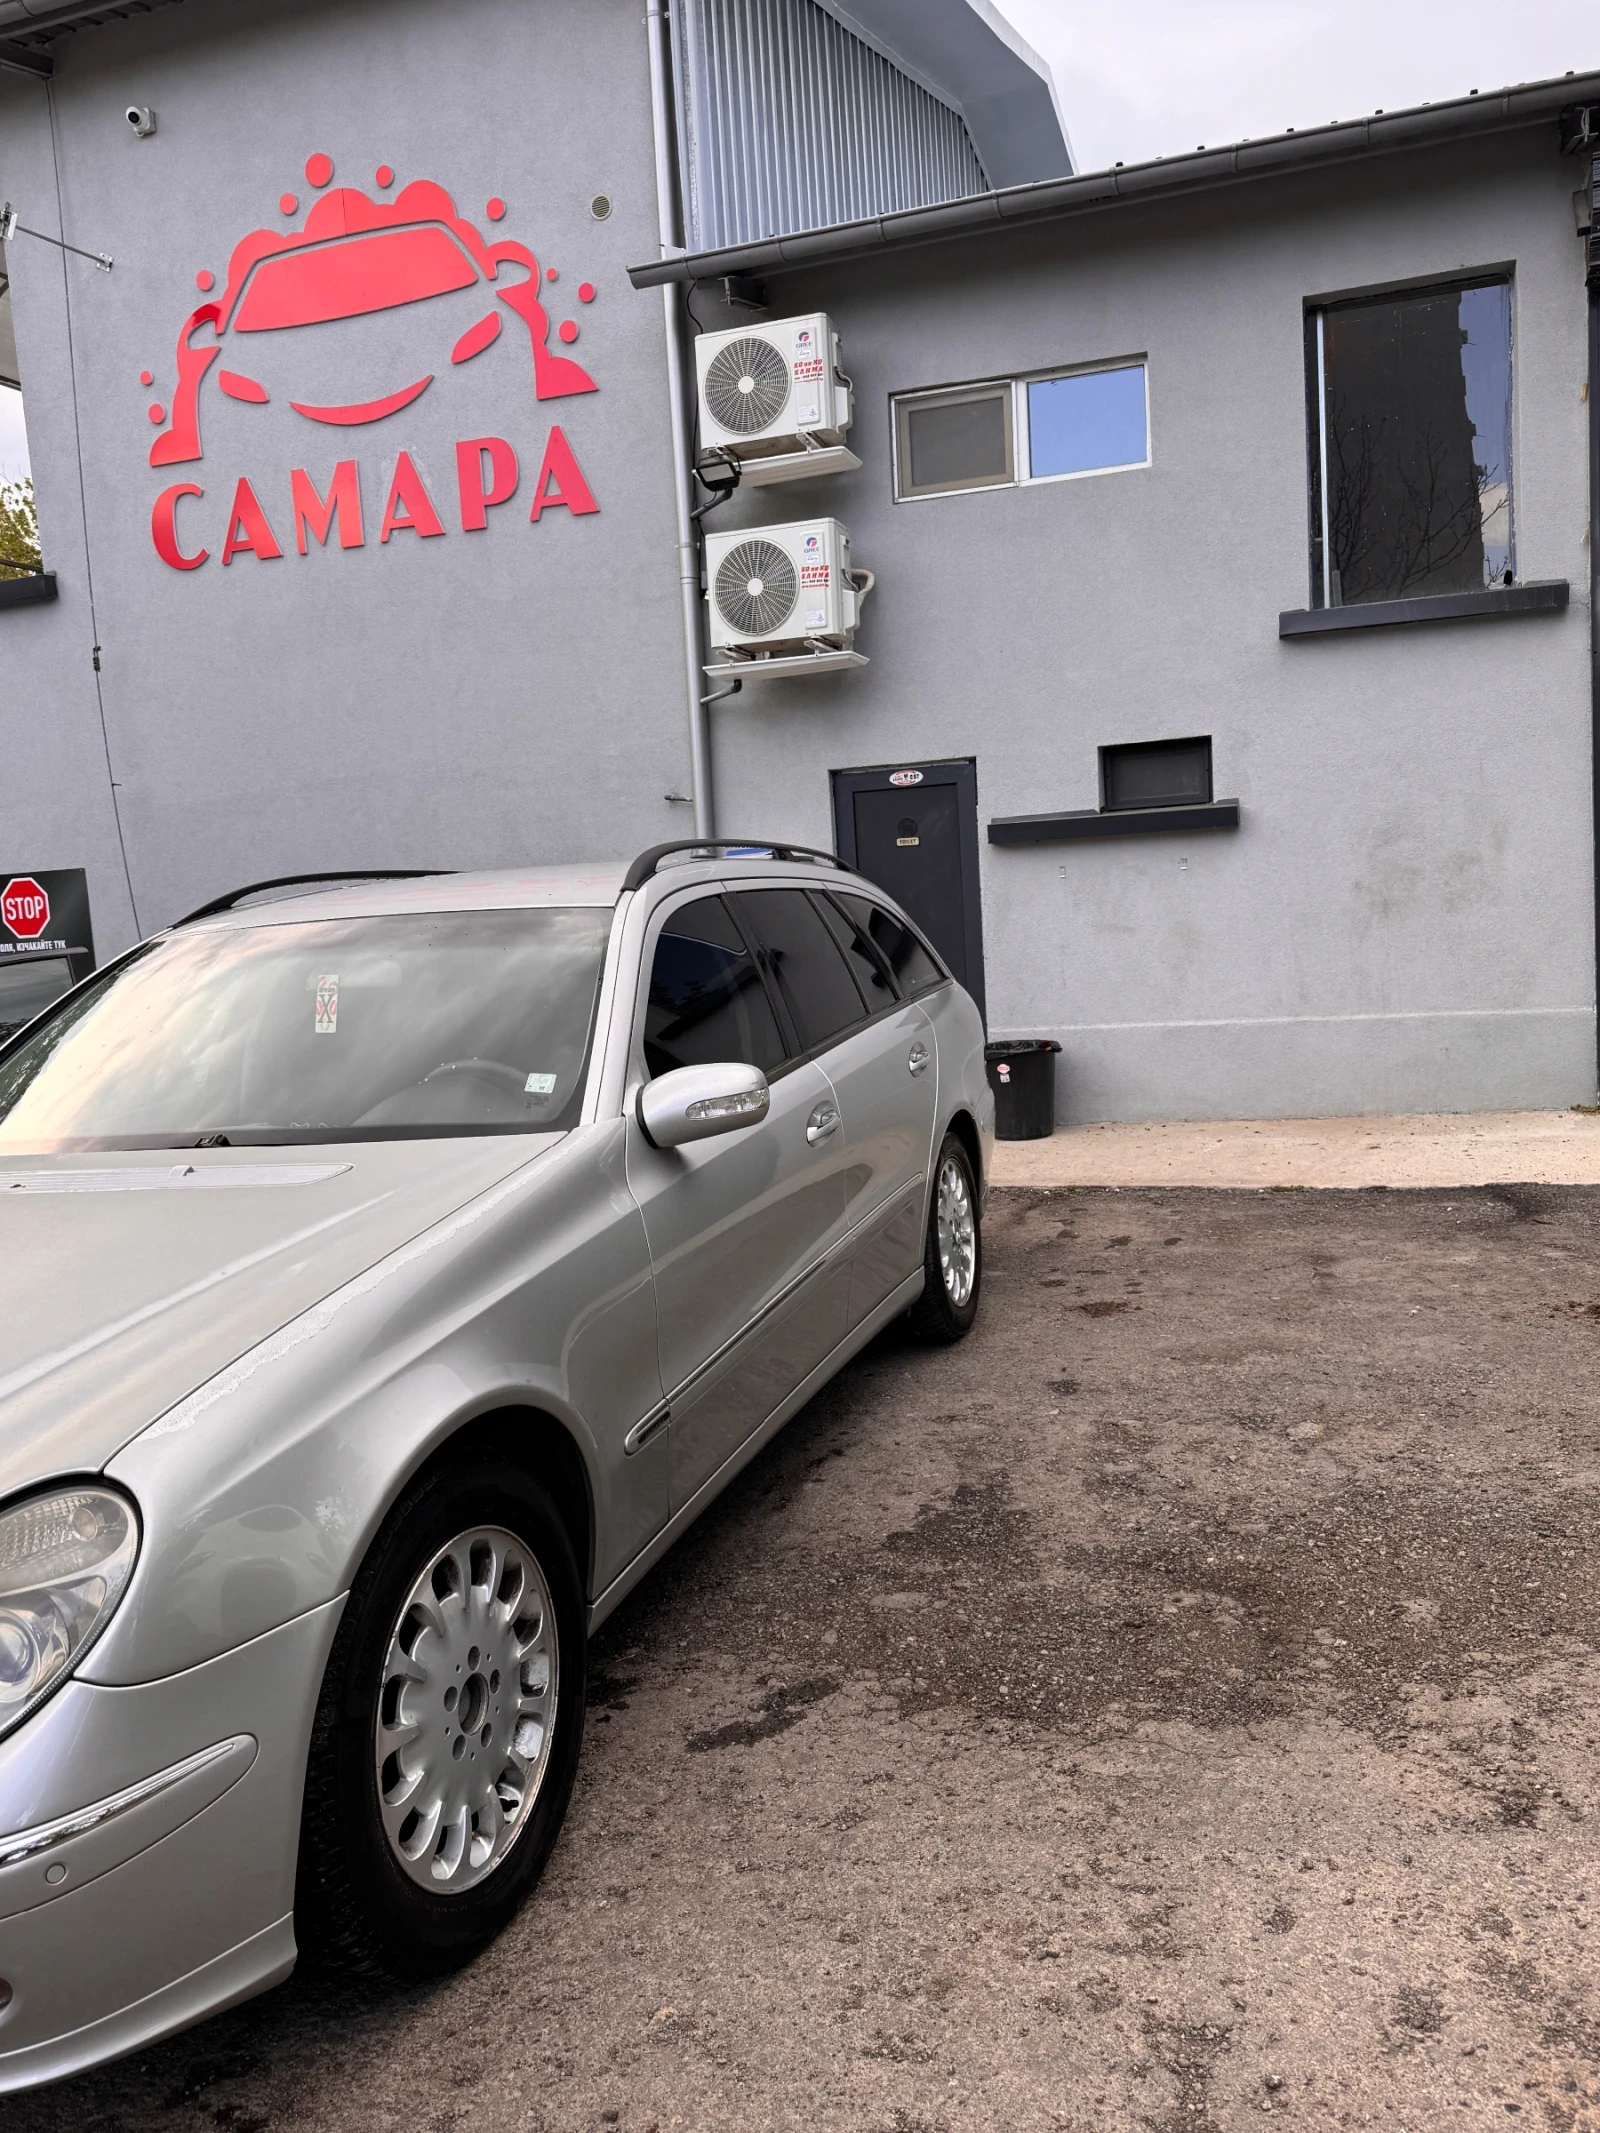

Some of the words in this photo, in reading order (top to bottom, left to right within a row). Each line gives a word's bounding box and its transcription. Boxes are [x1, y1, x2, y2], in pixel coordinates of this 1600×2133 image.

[151, 425, 599, 571] САМАРА
[6, 895, 44, 920] STOP
[16, 939, 53, 951] ИЗЧАКАЙТЕ
[54, 940, 66, 949] ТУК
